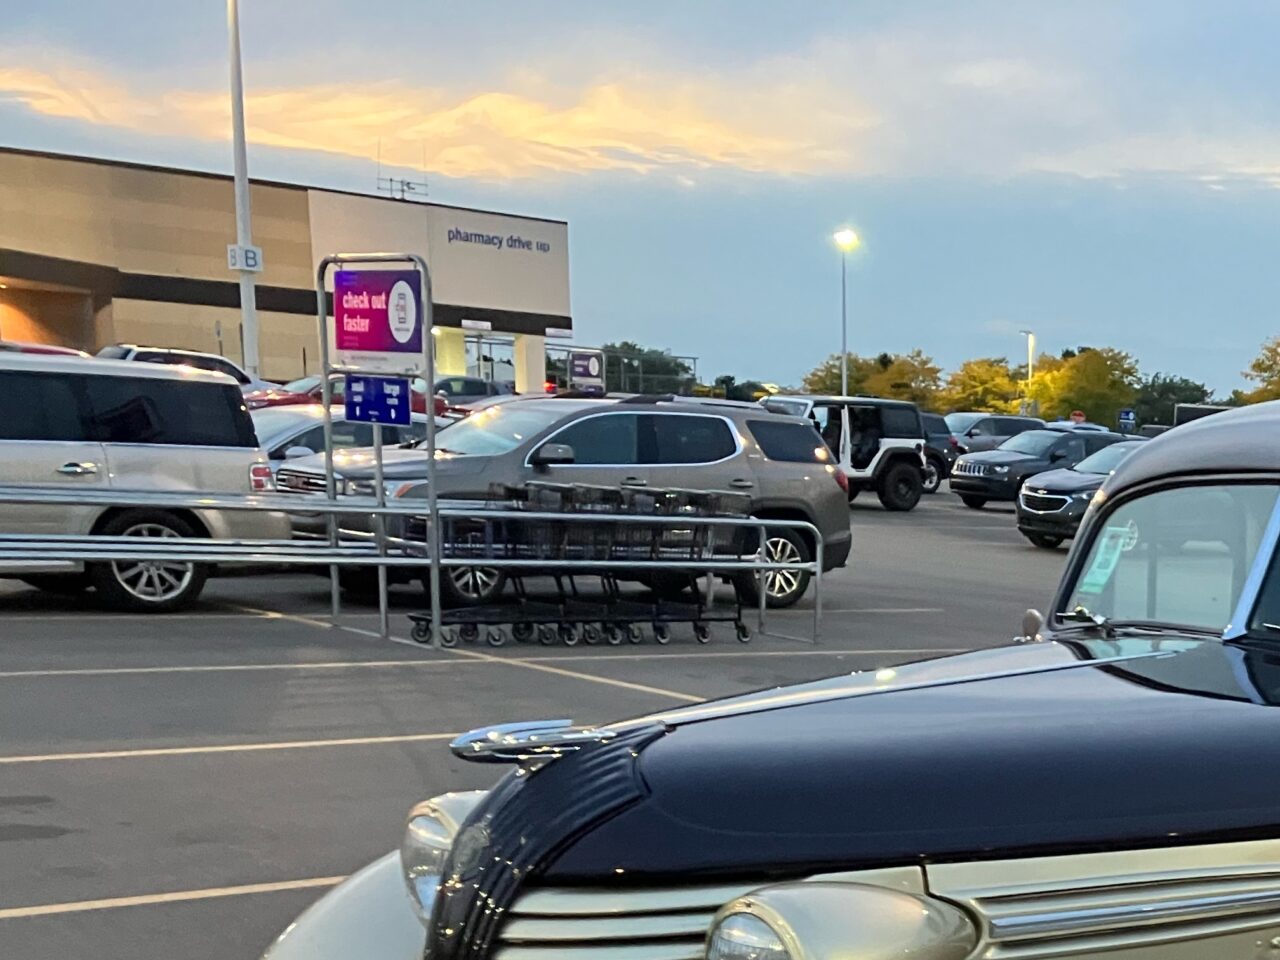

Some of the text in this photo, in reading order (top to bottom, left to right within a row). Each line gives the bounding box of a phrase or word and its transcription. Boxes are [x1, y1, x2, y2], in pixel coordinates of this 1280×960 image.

[447, 227, 551, 253] pharmacy drive up
[244, 249, 257, 268] B
[342, 290, 387, 310] check out
[343, 313, 370, 332] faster
